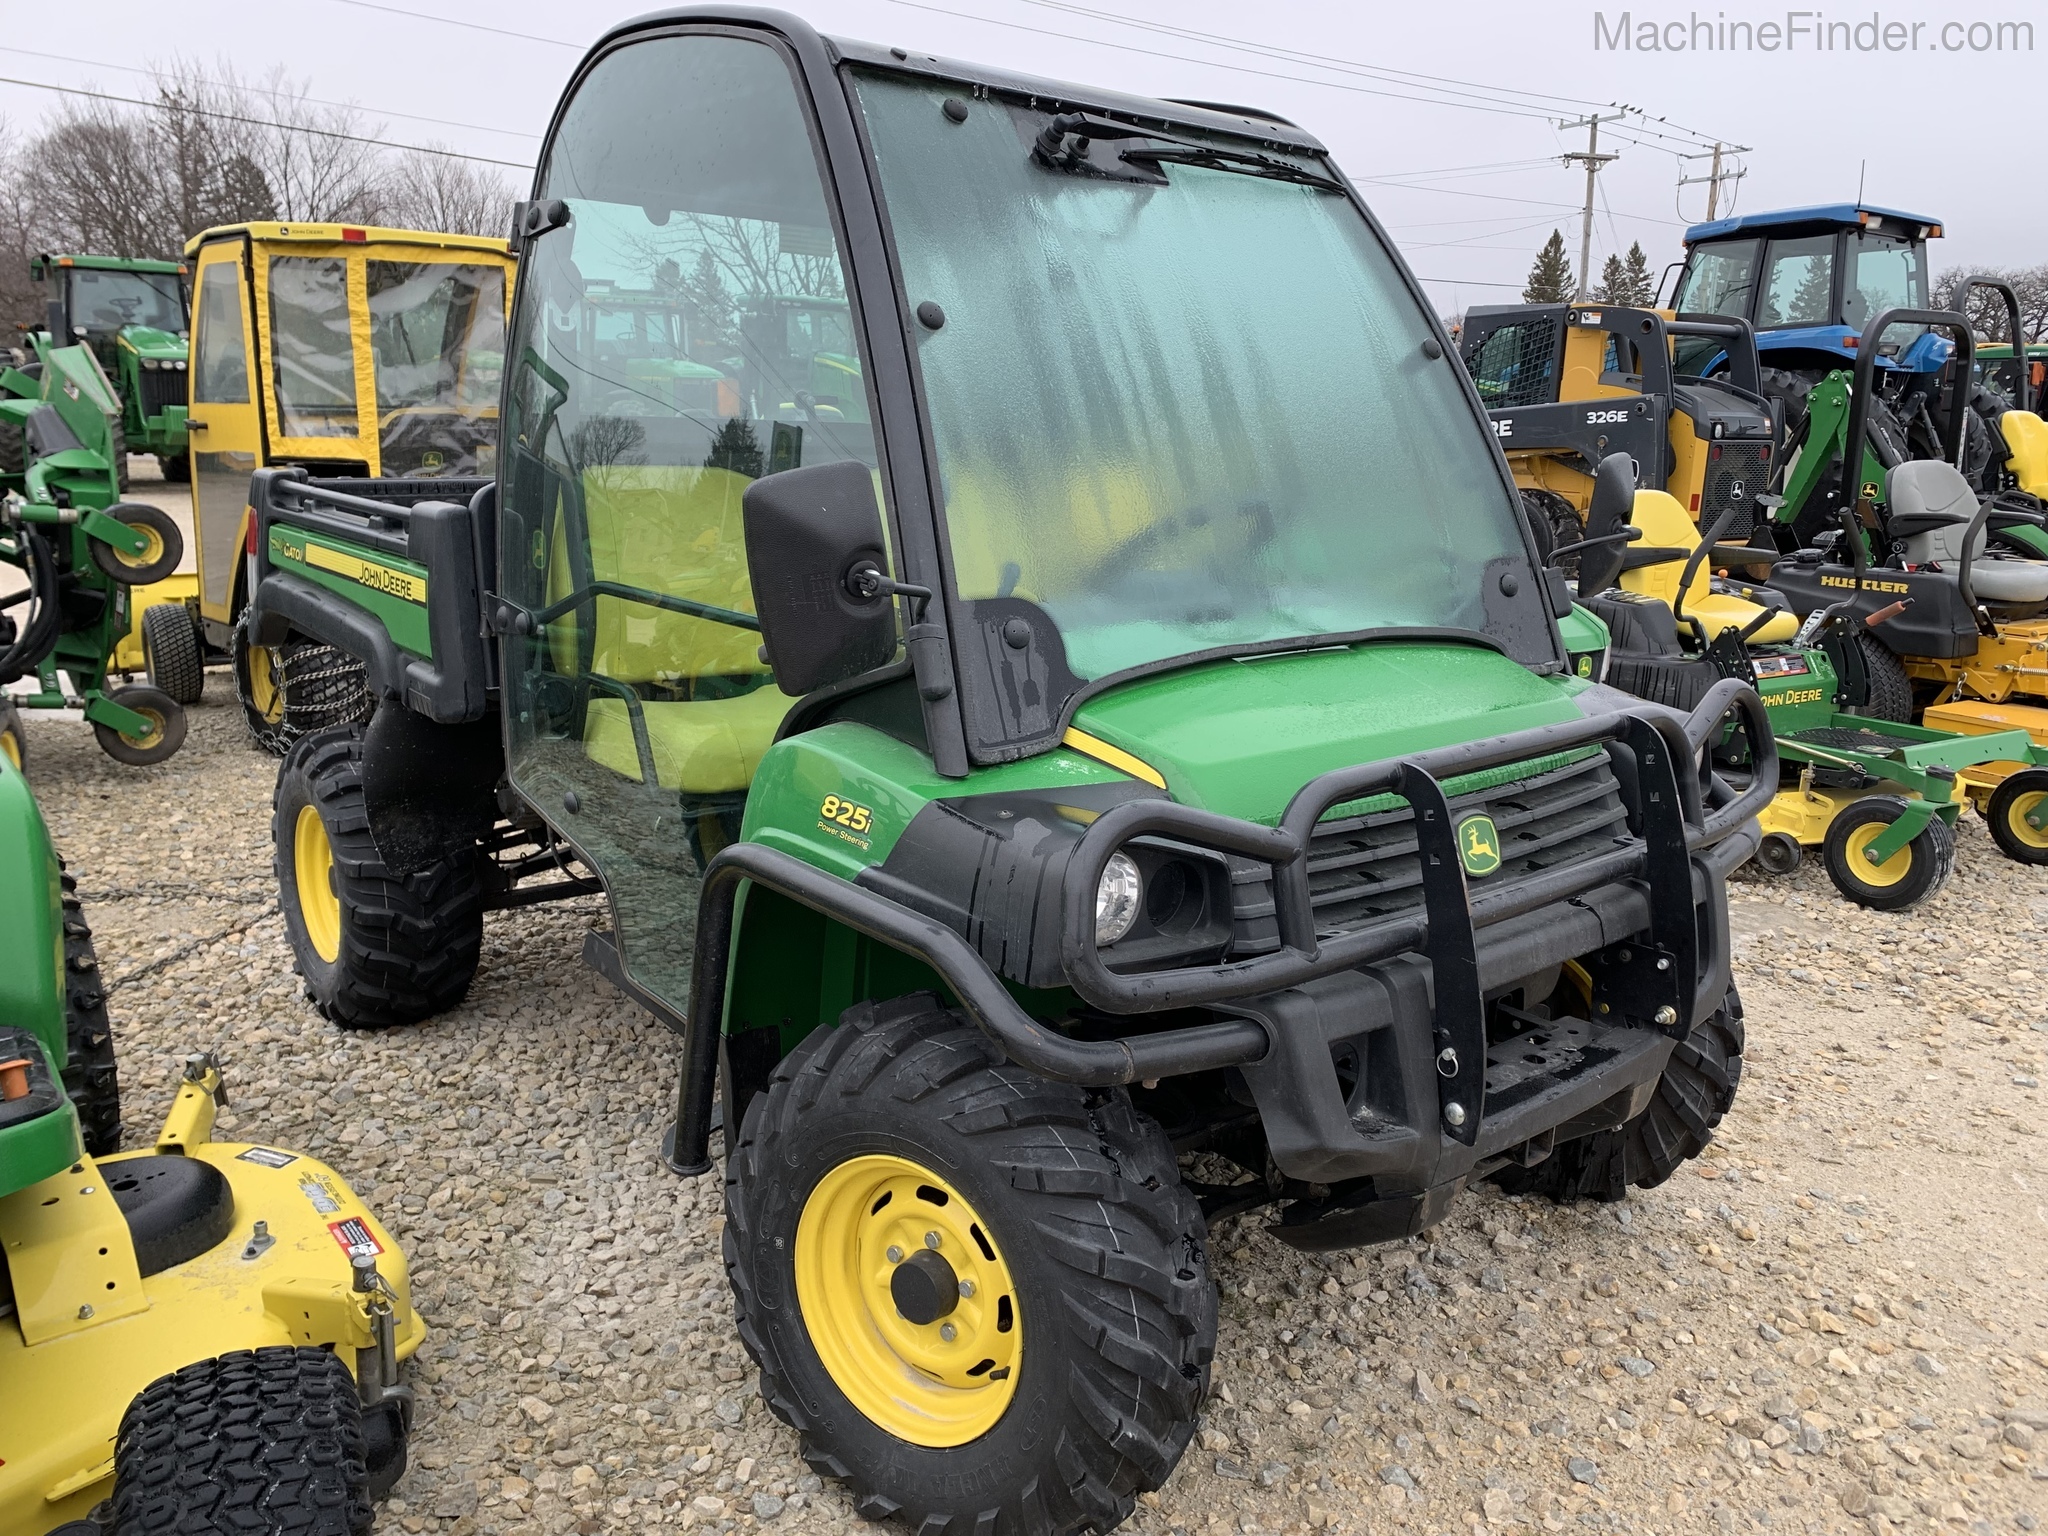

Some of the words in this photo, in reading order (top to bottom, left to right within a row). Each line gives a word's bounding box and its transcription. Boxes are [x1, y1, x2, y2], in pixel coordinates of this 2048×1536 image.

[1586, 410, 1629, 425] 326E
[359, 563, 382, 588] JOHN
[382, 569, 413, 599] DEERE
[1760, 693, 1784, 708] OHN
[1785, 688, 1823, 705] DEERE
[821, 795, 873, 834] 825i
[817, 821, 839, 836] Power
[839, 830, 870, 851] Steering
